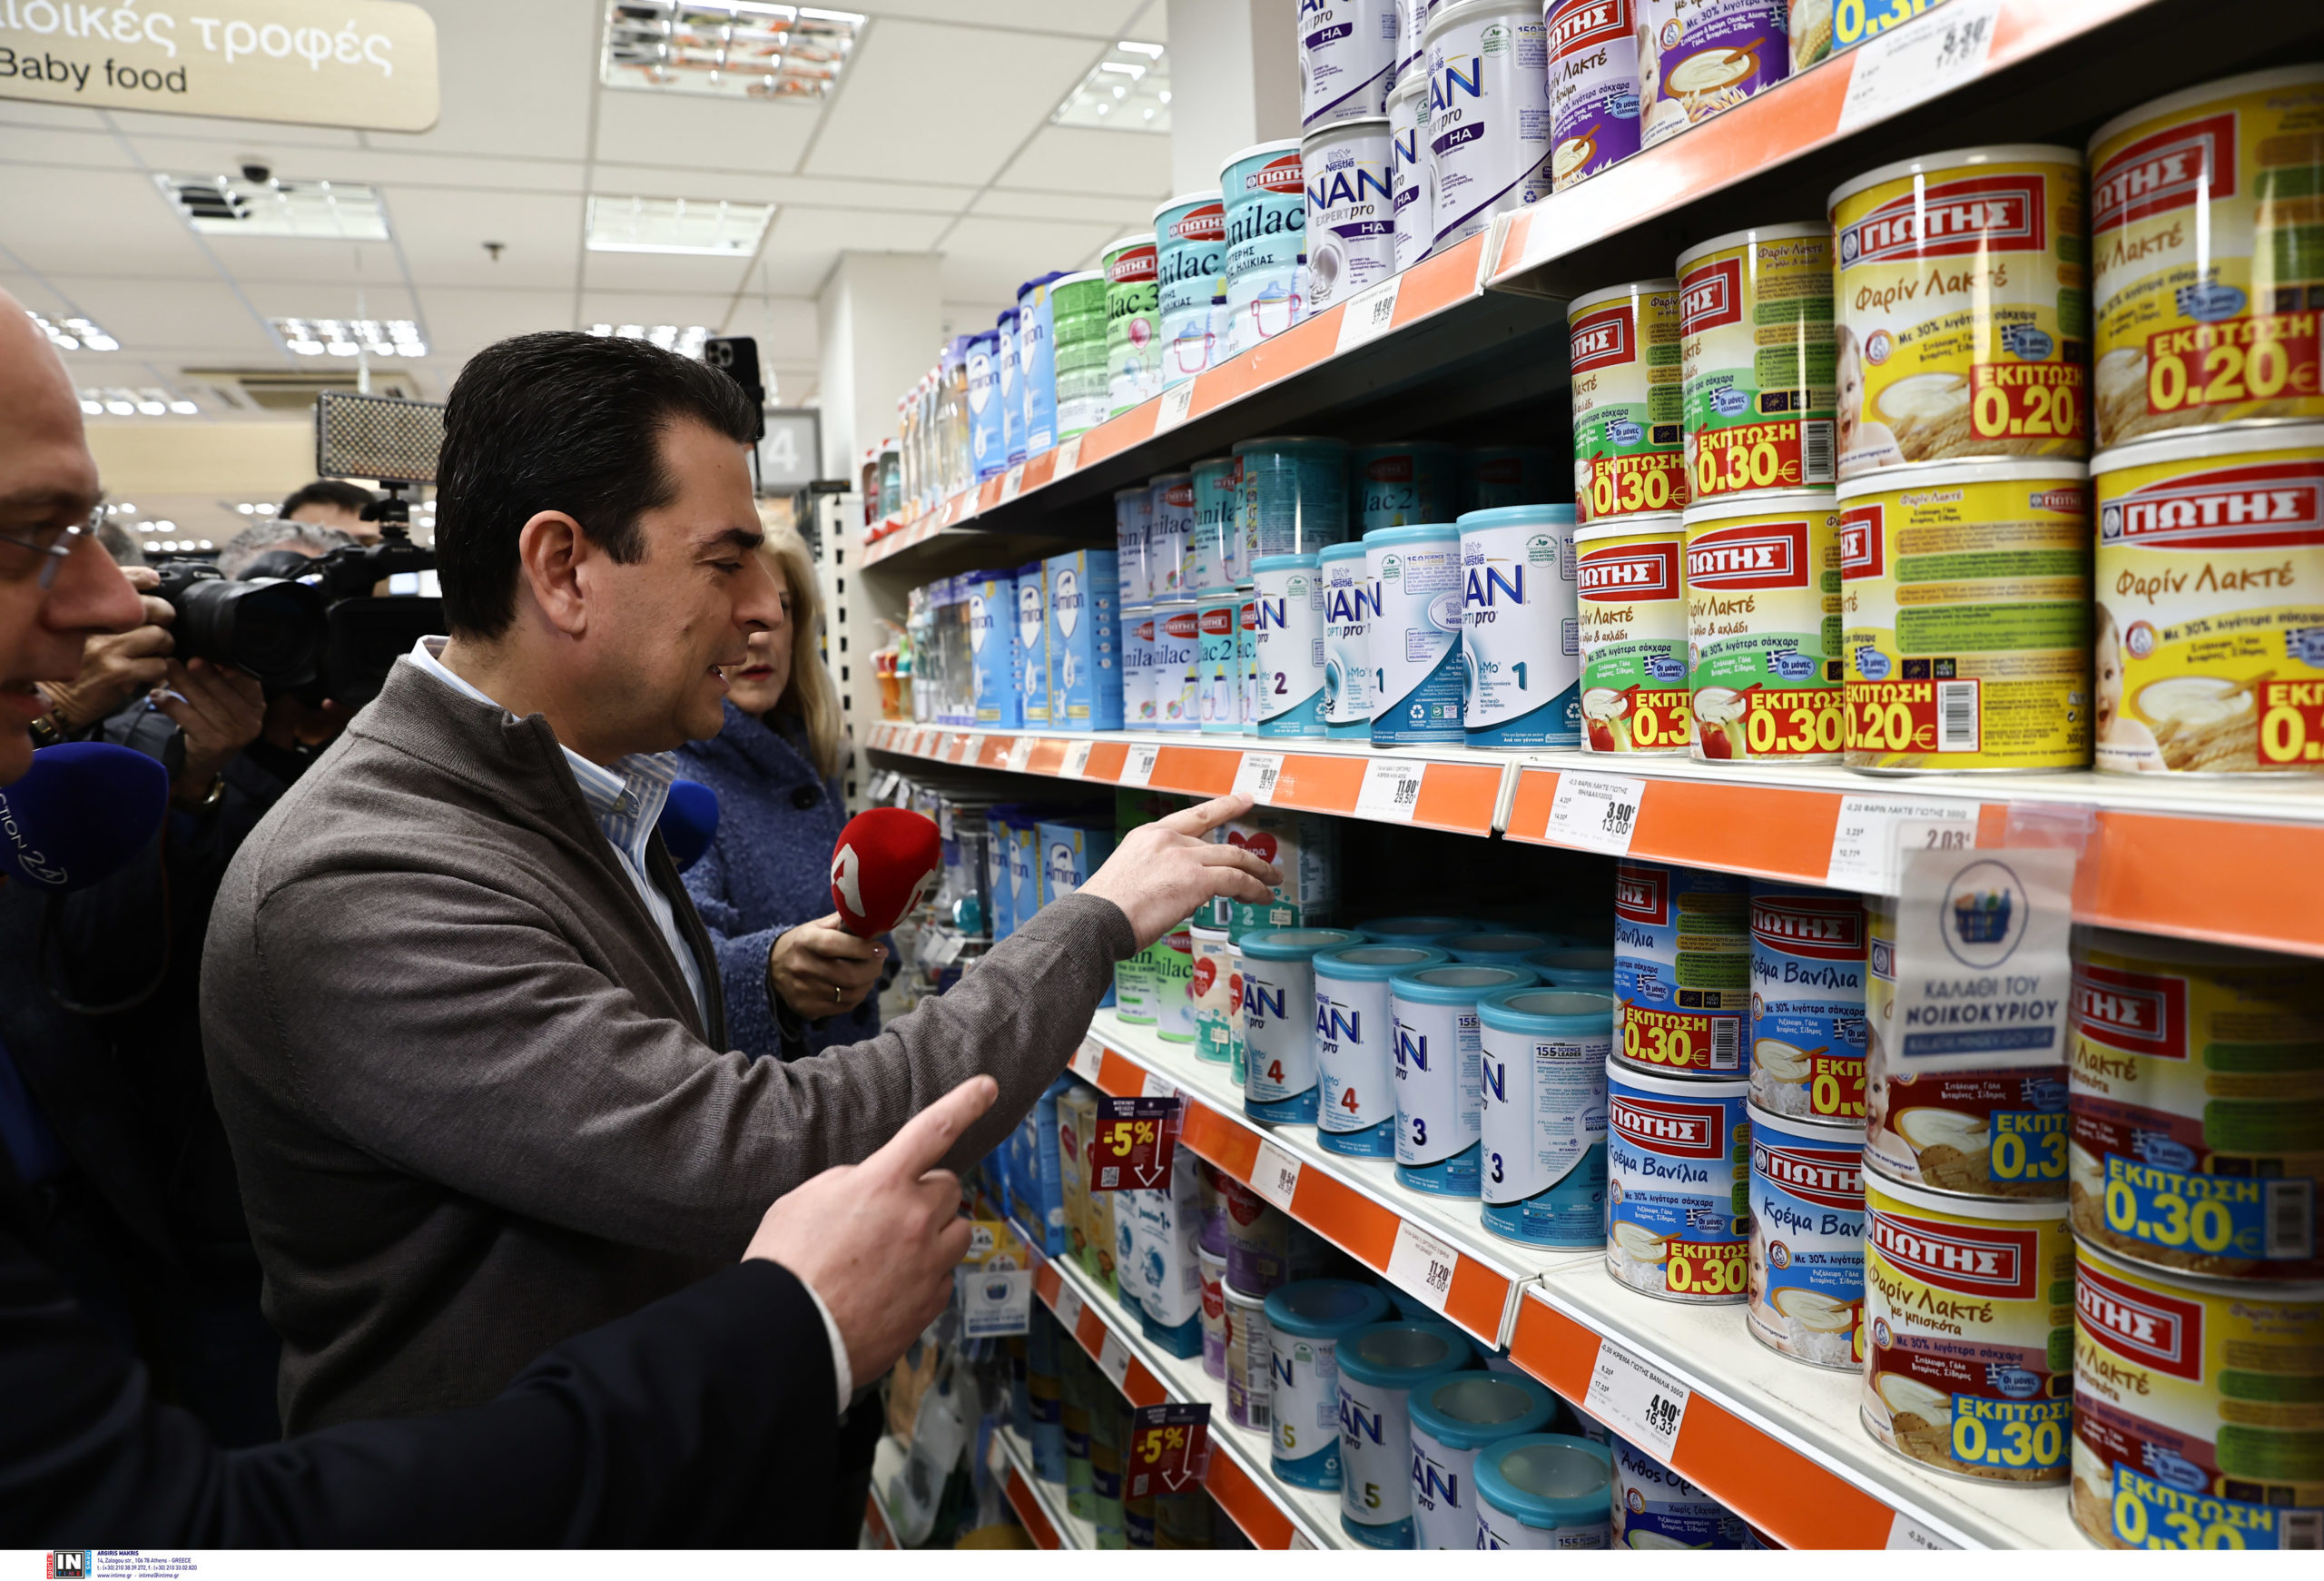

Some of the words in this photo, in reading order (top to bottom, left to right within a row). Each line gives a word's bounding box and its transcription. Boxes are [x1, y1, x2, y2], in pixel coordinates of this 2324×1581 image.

[191, 16, 393, 78] τροφές
[1321, 28, 1343, 42] HA
[0, 47, 90, 92] Baby
[104, 58, 188, 93] food
[1562, 47, 1608, 83] Λακτέ
[1450, 127, 1472, 145] HA
[1324, 157, 1354, 173] Nestlé
[1307, 167, 1393, 218] NAN
[1362, 222, 1385, 234] HA
[1864, 201, 2010, 252] ΓΙΩΤΗΣ
[2112, 221, 2184, 265] Λακτέ
[1856, 278, 1919, 313] Φαρίν
[2153, 315, 2314, 358] ΕΚΠΤΩΣΗ
[1978, 365, 2084, 388] ΕΚΠΤΩΣΗ
[767, 427, 800, 472] 4
[1700, 424, 1796, 452] ΕΚΠΤΩΣΗ
[1595, 454, 1684, 477] ΕΚΠΤΩΣΗ
[2127, 491, 2299, 536] ΓΙΩΤΗΣ
[1464, 554, 1485, 568] Nestlé
[1688, 546, 1775, 576] ΓΙΩΤΗΣ
[1331, 578, 1354, 588] Nestlé
[2116, 568, 2189, 605] Φαρίν
[2195, 561, 2295, 593] Λακτέ
[1051, 590, 1085, 610] Almiron
[1709, 594, 1756, 616] Λακτέ
[1593, 606, 1634, 625] Λακτέ
[1718, 623, 1748, 637] αχλάδι
[1221, 640, 1233, 661] 2
[1609, 646, 1637, 658] λιγότερα
[1639, 643, 1671, 654] σάκχαρα
[1709, 644, 1723, 657] 30%
[1726, 640, 1758, 656] λιγότερα
[1761, 637, 1799, 648] σάκχαρα
[1512, 661, 1528, 691] 1
[1782, 660, 1789, 669] Οι
[1791, 660, 1811, 671] μόνες
[1275, 672, 1288, 695] 2
[1375, 667, 1384, 693] 1
[1751, 692, 1843, 709] ΕΚΠΤΩΣ
[1846, 684, 1932, 704] ΕΚΠΤΩΣΗ
[1397, 779, 1420, 794] 11,80€
[1578, 780, 1591, 788] ΦΑΡΙΝ
[1592, 783, 1609, 791] ΛΑΚΤΕ
[1610, 786, 1628, 795] ΓΙΩΤΗΣ
[0, 793, 27, 849] CTION
[1607, 801, 1636, 822] 3,90€
[1864, 805, 1886, 814] ΦΑΡΙΝ
[1888, 806, 1913, 815] ΛΑΚΤΕ
[1915, 808, 1944, 817] ΓΙΩΤΗΣ
[1601, 818, 1631, 835] 13,00€
[1616, 922, 1654, 949] Βανίλια
[1752, 909, 1843, 940] ΓΙΩΤΗΣ
[1785, 961, 1858, 989] Βανίλια
[1924, 977, 1997, 1000] ΚΑΛΑΘΙ
[2004, 975, 2041, 996] ΤΟΥ
[1626, 1007, 1708, 1032] ΕΚΠΤΩΣΗ
[1766, 1004, 1774, 1013] Με
[1775, 1003, 1789, 1013] 30%
[1792, 1003, 1825, 1016] λιγότερα
[1827, 1005, 1865, 1018] σάκχαρα
[1907, 1000, 2058, 1026] ΝΟΙΚΟΚΥΡΙΟΥ
[1536, 1047, 1558, 1057] 155
[2078, 1041, 2138, 1082] Λακτέ
[1267, 1059, 1285, 1084] 4
[1341, 1087, 1359, 1114] 4
[1412, 1118, 1427, 1146] 3
[1612, 1102, 1696, 1141] ΓΙΩΤΗΣ
[1103, 1121, 1155, 1157] -5%
[1491, 1152, 1504, 1183] 3
[1642, 1157, 1709, 1183] Βανίλια
[2109, 1158, 2259, 1204] ΕΚΠΤΩΣΗ
[1624, 1191, 1632, 1201] Με
[1634, 1191, 1648, 1201] 30%
[1649, 1194, 1679, 1207] λιγότερα
[1681, 1195, 1714, 1209] σάκχαρα
[1764, 1196, 1813, 1234] Κρέμα
[1670, 1242, 1748, 1260] ΕΚΠΤΩΣ
[1875, 1220, 1999, 1275] ΓΙΩΤΗΣ
[1426, 1273, 1449, 1292] 28,00€
[1430, 1260, 1452, 1282] 11,20€
[1868, 1264, 1913, 1307] Φαρίν
[1918, 1285, 1994, 1323] Λακτέ
[1890, 1303, 1904, 1319] με
[1905, 1309, 1963, 1336] μπισκότα
[1896, 1335, 1908, 1347] Με
[1910, 1337, 1930, 1349] 30%
[1934, 1342, 1976, 1358] λιγότερα
[1613, 1349, 1630, 1366] ΚΡΕΜΑ
[1630, 1359, 1649, 1378] ΓΙΩΤΗΣ
[1649, 1370, 1670, 1391] ΒΑΝΙΛΙΑ
[2087, 1346, 2151, 1396] Λακτέ
[1650, 1394, 1681, 1423] 4,90€
[1957, 1398, 2072, 1422] ΕΚΠΤΩΣΗ
[1645, 1408, 1677, 1436] 16,33€
[1137, 1427, 1185, 1464] -5%
[1283, 1426, 1296, 1449] 5
[1621, 1448, 1661, 1484] Άνθος
[1364, 1483, 1381, 1509] 5
[2118, 1468, 2271, 1531] ΕΚΠΤΩΣΗ
